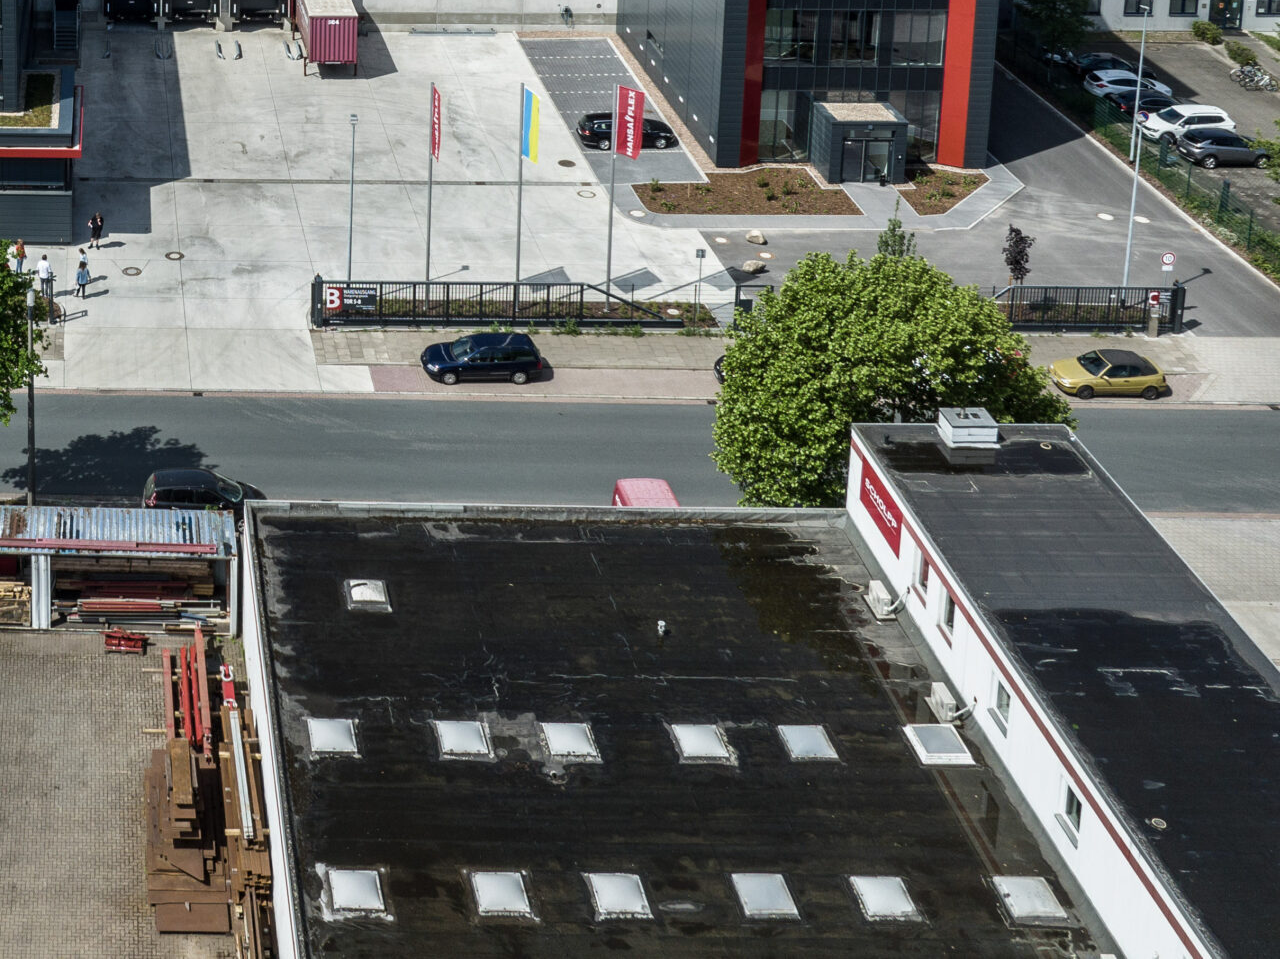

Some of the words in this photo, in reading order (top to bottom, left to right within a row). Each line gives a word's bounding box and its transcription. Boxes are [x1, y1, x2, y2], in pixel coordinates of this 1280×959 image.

[627, 89, 637, 116] FLEX
[626, 123, 635, 156] HANSA
[326, 288, 340, 308] B
[1149, 292, 1159, 305] C
[865, 478, 898, 528] SCHOLPP
